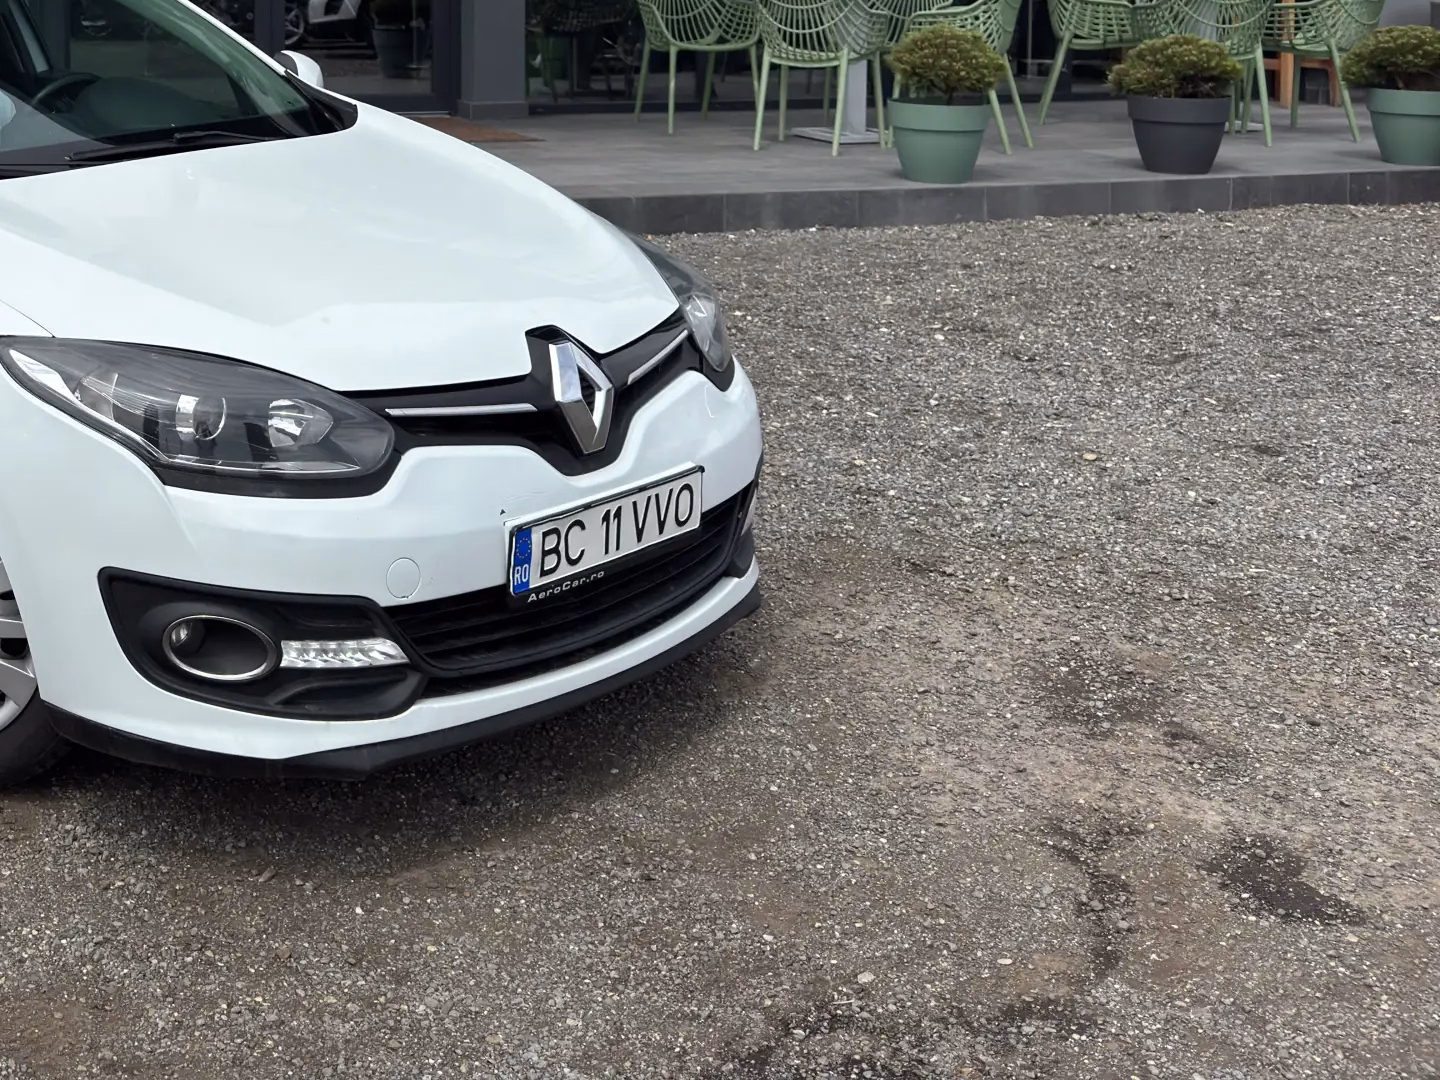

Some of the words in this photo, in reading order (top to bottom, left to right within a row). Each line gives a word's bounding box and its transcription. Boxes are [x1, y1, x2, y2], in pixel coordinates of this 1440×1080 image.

[539, 518, 586, 578] BC
[601, 505, 622, 556] 11
[632, 483, 694, 544] VVO
[514, 564, 530, 586] RO
[527, 570, 605, 603] AeroCar.ro
